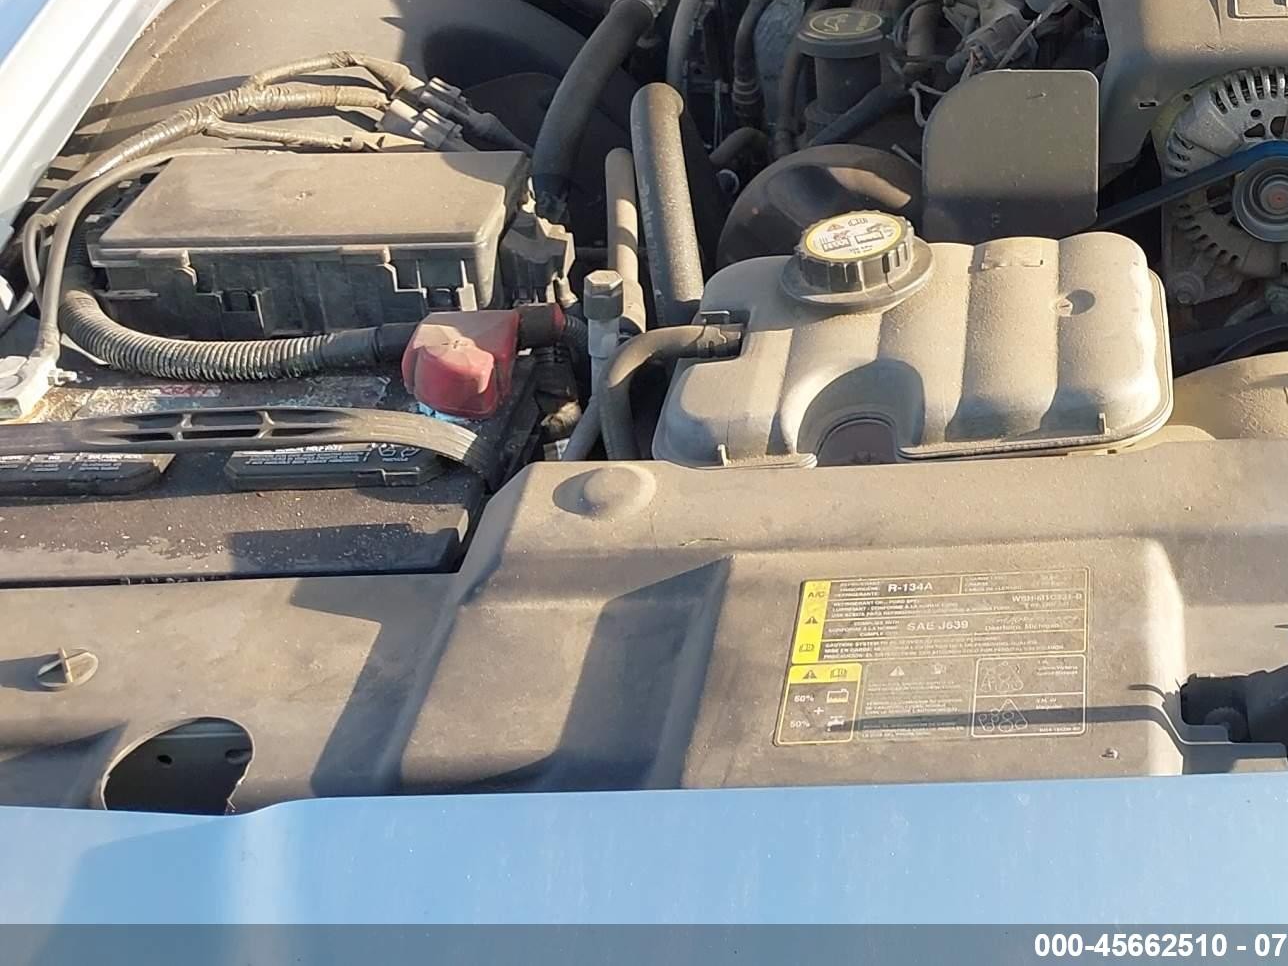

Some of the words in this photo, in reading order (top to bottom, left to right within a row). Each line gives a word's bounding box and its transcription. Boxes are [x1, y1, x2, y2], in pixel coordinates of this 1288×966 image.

[886, 581, 934, 594] R-134A
[807, 591, 826, 599] A/C
[906, 621, 935, 632] SAE
[937, 619, 969, 631] J639
